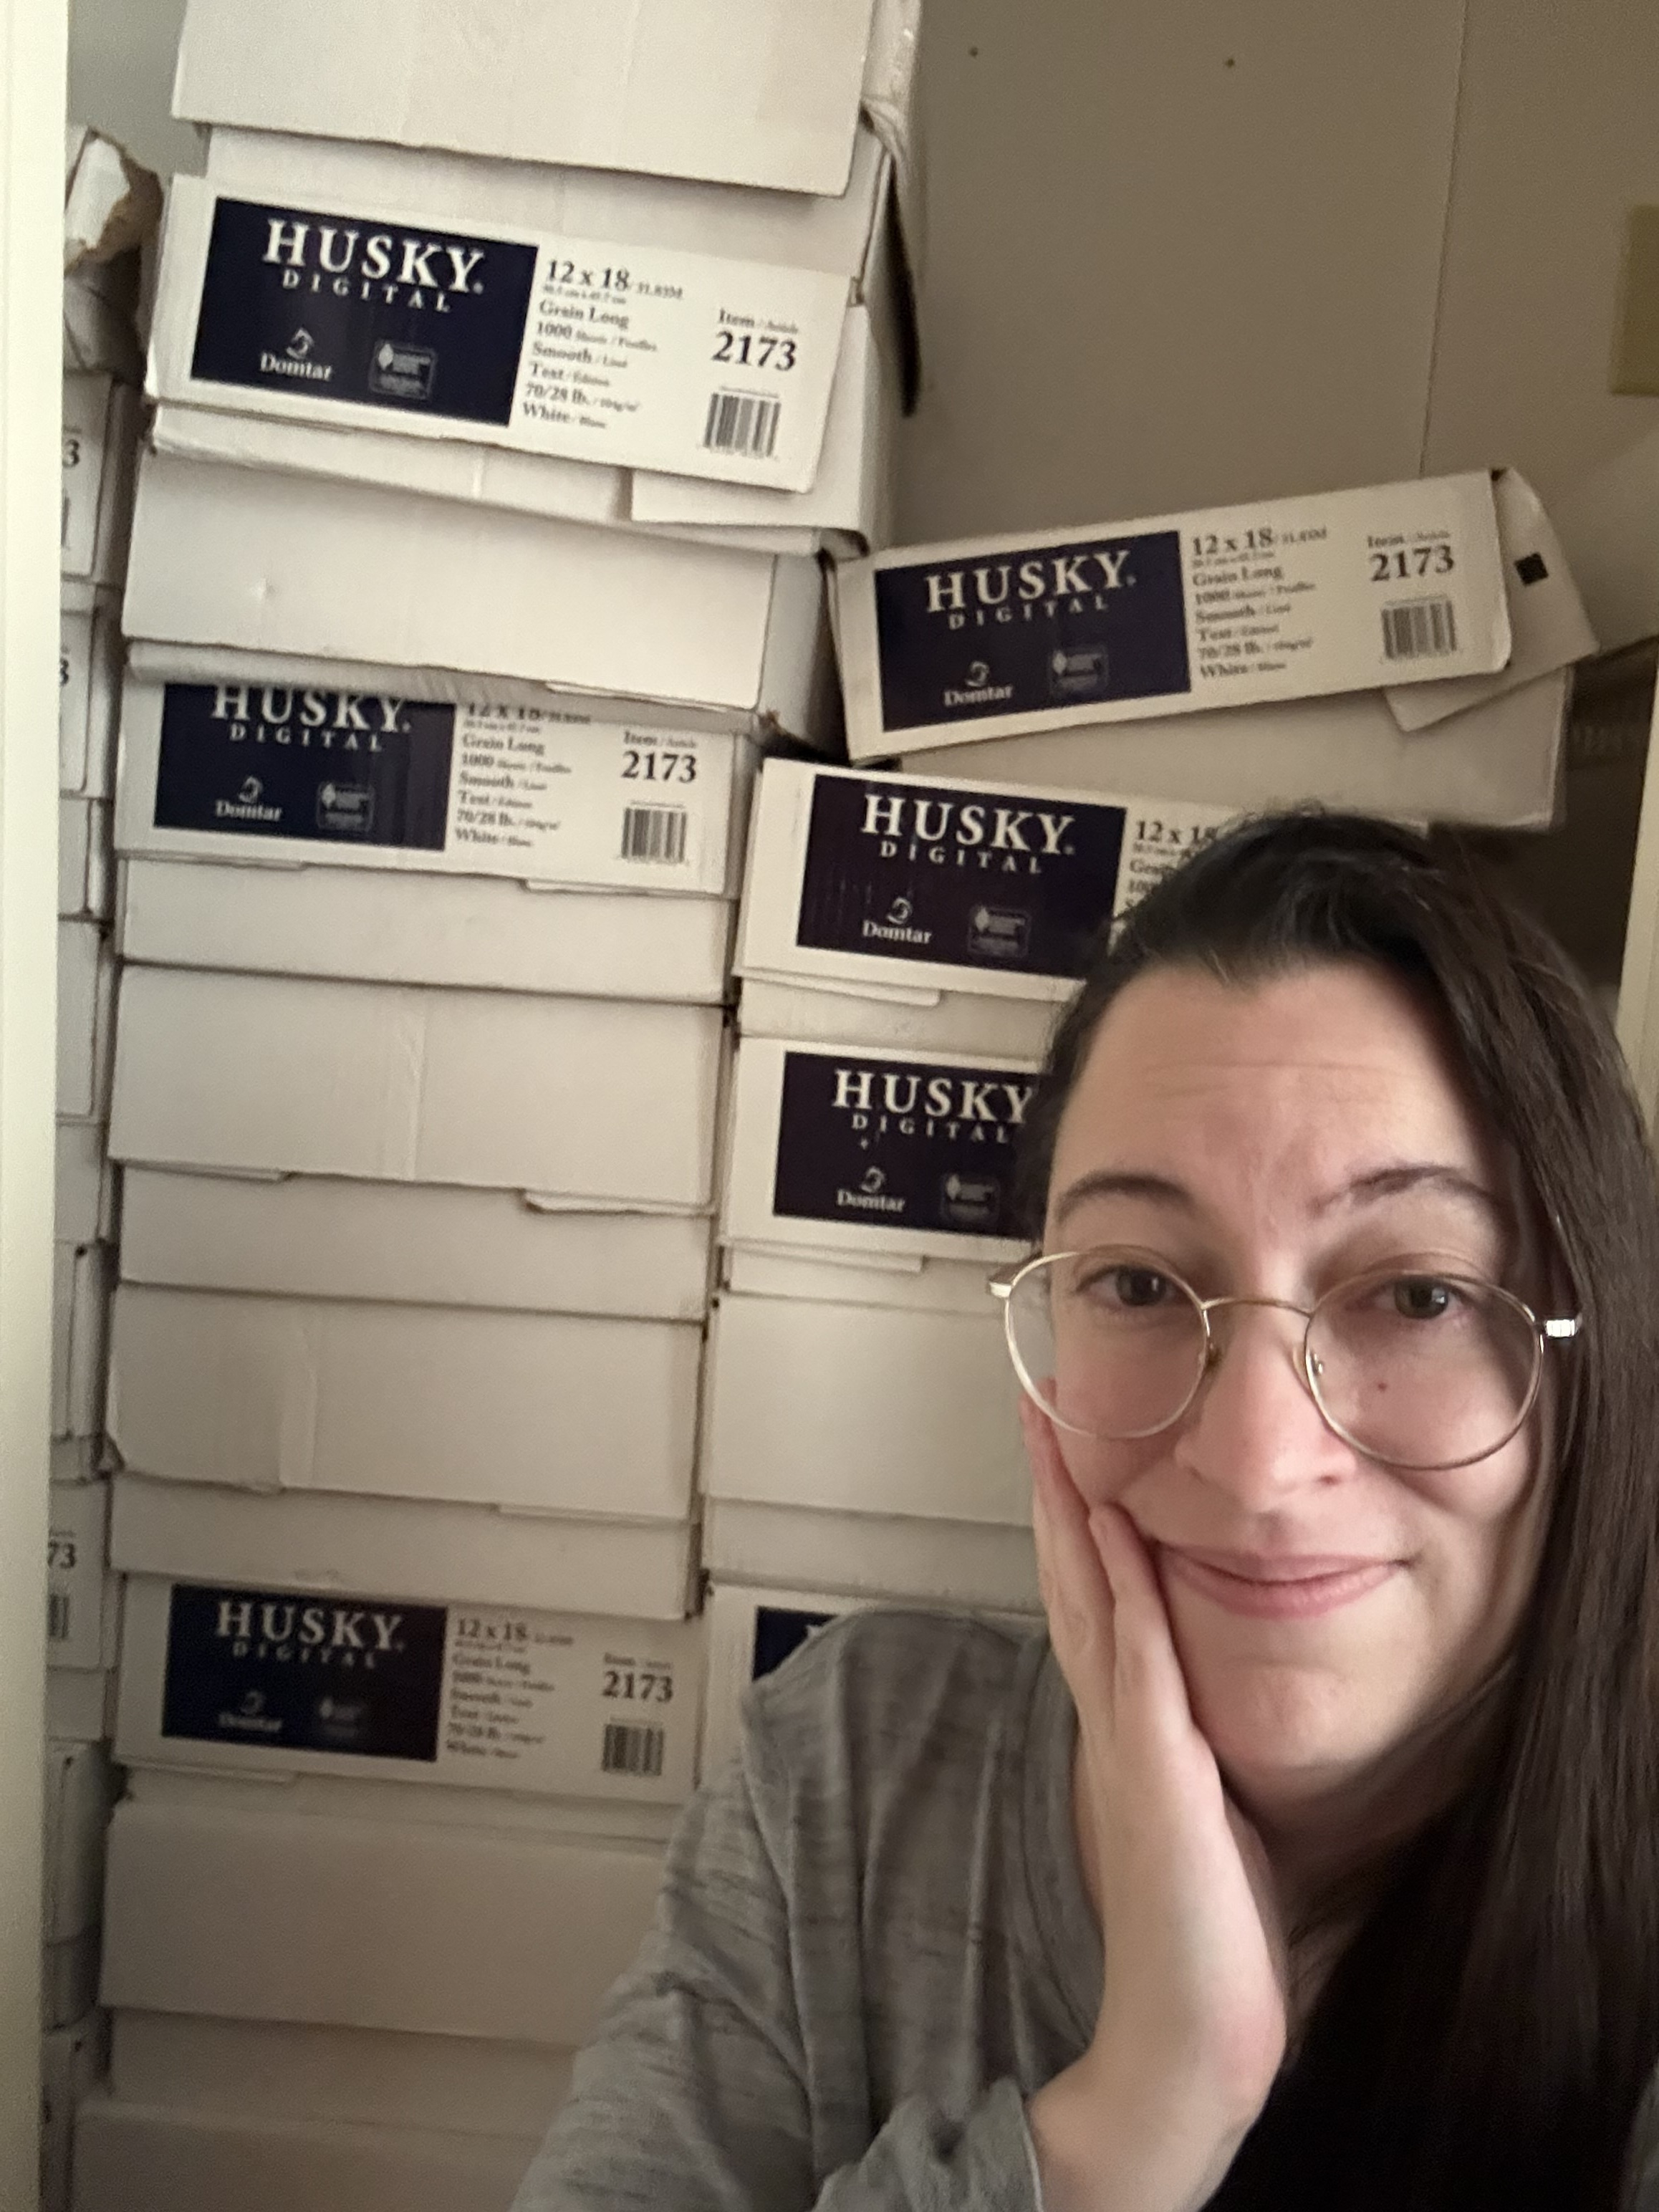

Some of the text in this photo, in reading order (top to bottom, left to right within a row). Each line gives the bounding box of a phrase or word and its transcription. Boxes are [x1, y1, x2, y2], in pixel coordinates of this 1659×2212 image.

[262, 218, 484, 294] HUSKY
[282, 269, 452, 313] DIGITAL
[548, 259, 574, 284] 12
[580, 269, 593, 287] x
[602, 266, 630, 292] 18
[260, 351, 332, 381] Domtar
[711, 329, 797, 371] 2173
[1193, 534, 1217, 555] 12
[1246, 527, 1273, 549] 18
[1370, 544, 1454, 582] 2173
[925, 549, 1130, 613] HUSKY
[948, 595, 1108, 631] DIGITAL
[211, 686, 403, 733] HUSKY
[943, 683, 1014, 708] Domtar
[230, 724, 382, 752] DIGITAL
[622, 750, 696, 784] 2173
[216, 800, 283, 822] Domtar
[862, 794, 1074, 855] HUSKY
[1138, 821, 1162, 842] 12
[880, 840, 1042, 875] DIGITAL
[862, 919, 932, 945] Domtar
[832, 1067, 1033, 1124] HUSKY
[852, 1112, 1008, 1144] DIGITAL
[836, 1188, 905, 1213] Domtar
[216, 1600, 401, 1650] HUSKY
[233, 1640, 375, 1669] DIGITAL
[603, 1670, 673, 1704] 2173
